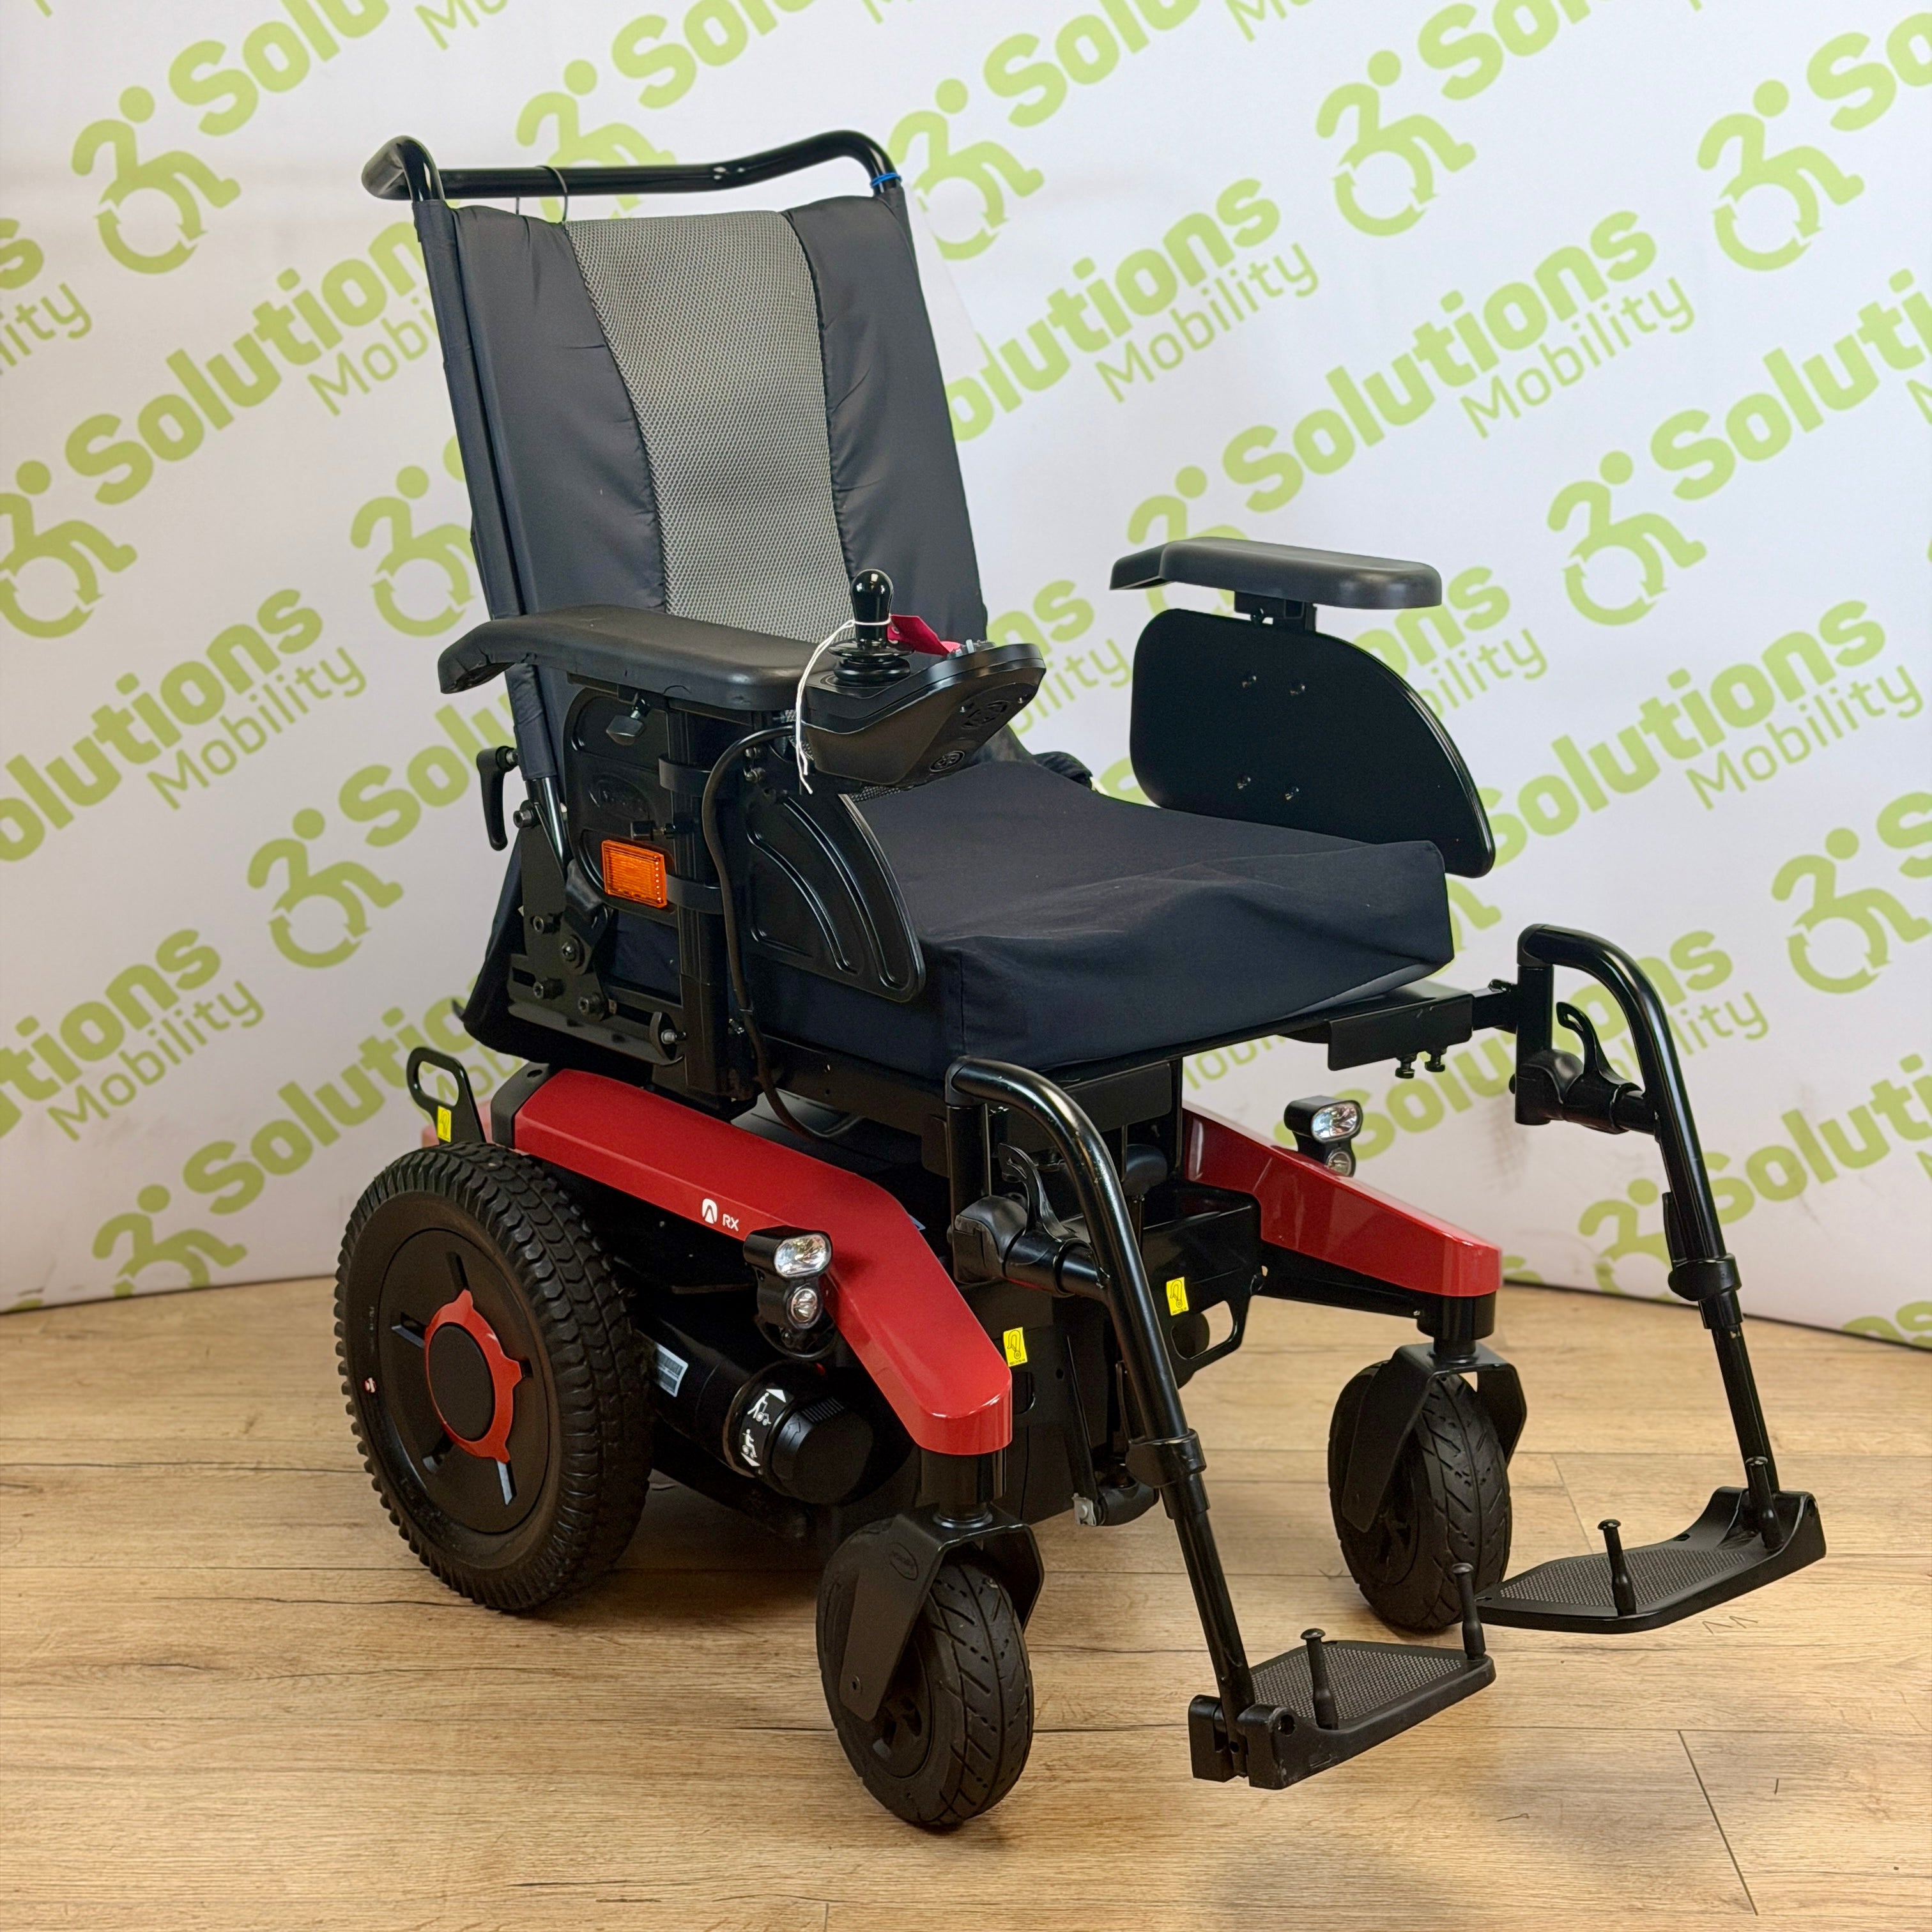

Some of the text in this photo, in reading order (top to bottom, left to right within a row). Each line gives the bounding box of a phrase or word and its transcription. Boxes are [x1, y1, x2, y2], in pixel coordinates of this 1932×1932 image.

[64, 221, 427, 505] Solution
[307, 296, 439, 415] Mobi
[944, 178, 1280, 442] olutions
[1096, 244, 1318, 402] Mobility
[1222, 211, 1656, 513] Solutions
[1460, 278, 1694, 438] Mobility
[146, 648, 366, 810] Mobility
[1686, 666, 1923, 809] Mobility
[0, 930, 220, 1138] tions
[47, 981, 263, 1141] Mobility
[182, 976, 478, 1215] Solutio
[723, 1213, 739, 1232] RX
